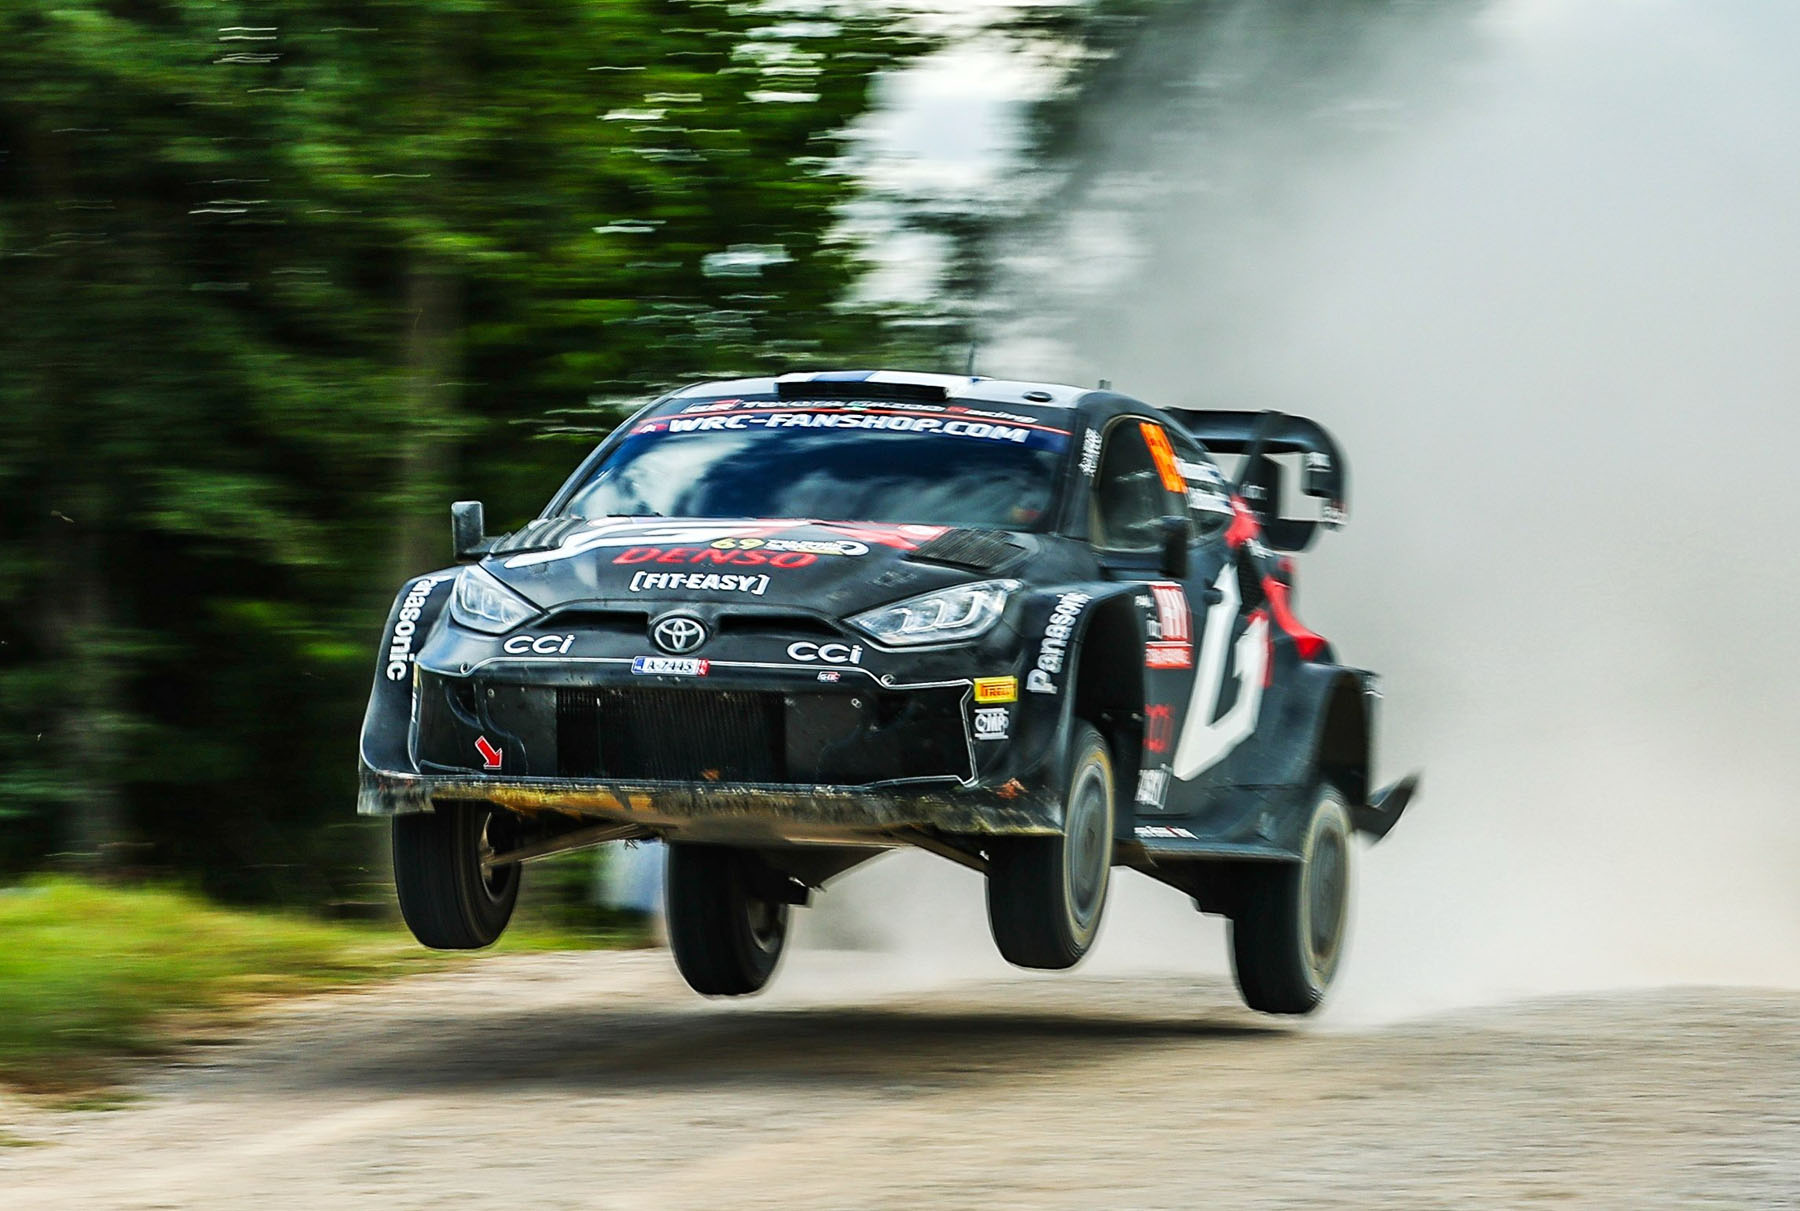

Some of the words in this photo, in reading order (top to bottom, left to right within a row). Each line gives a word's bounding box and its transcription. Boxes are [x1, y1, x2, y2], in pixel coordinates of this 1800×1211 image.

[743, 401, 843, 409] TOYOTA
[669, 414, 1030, 443] WRC-FANSHOP.COM
[710, 537, 765, 550] 69
[612, 547, 819, 569] DENSO
